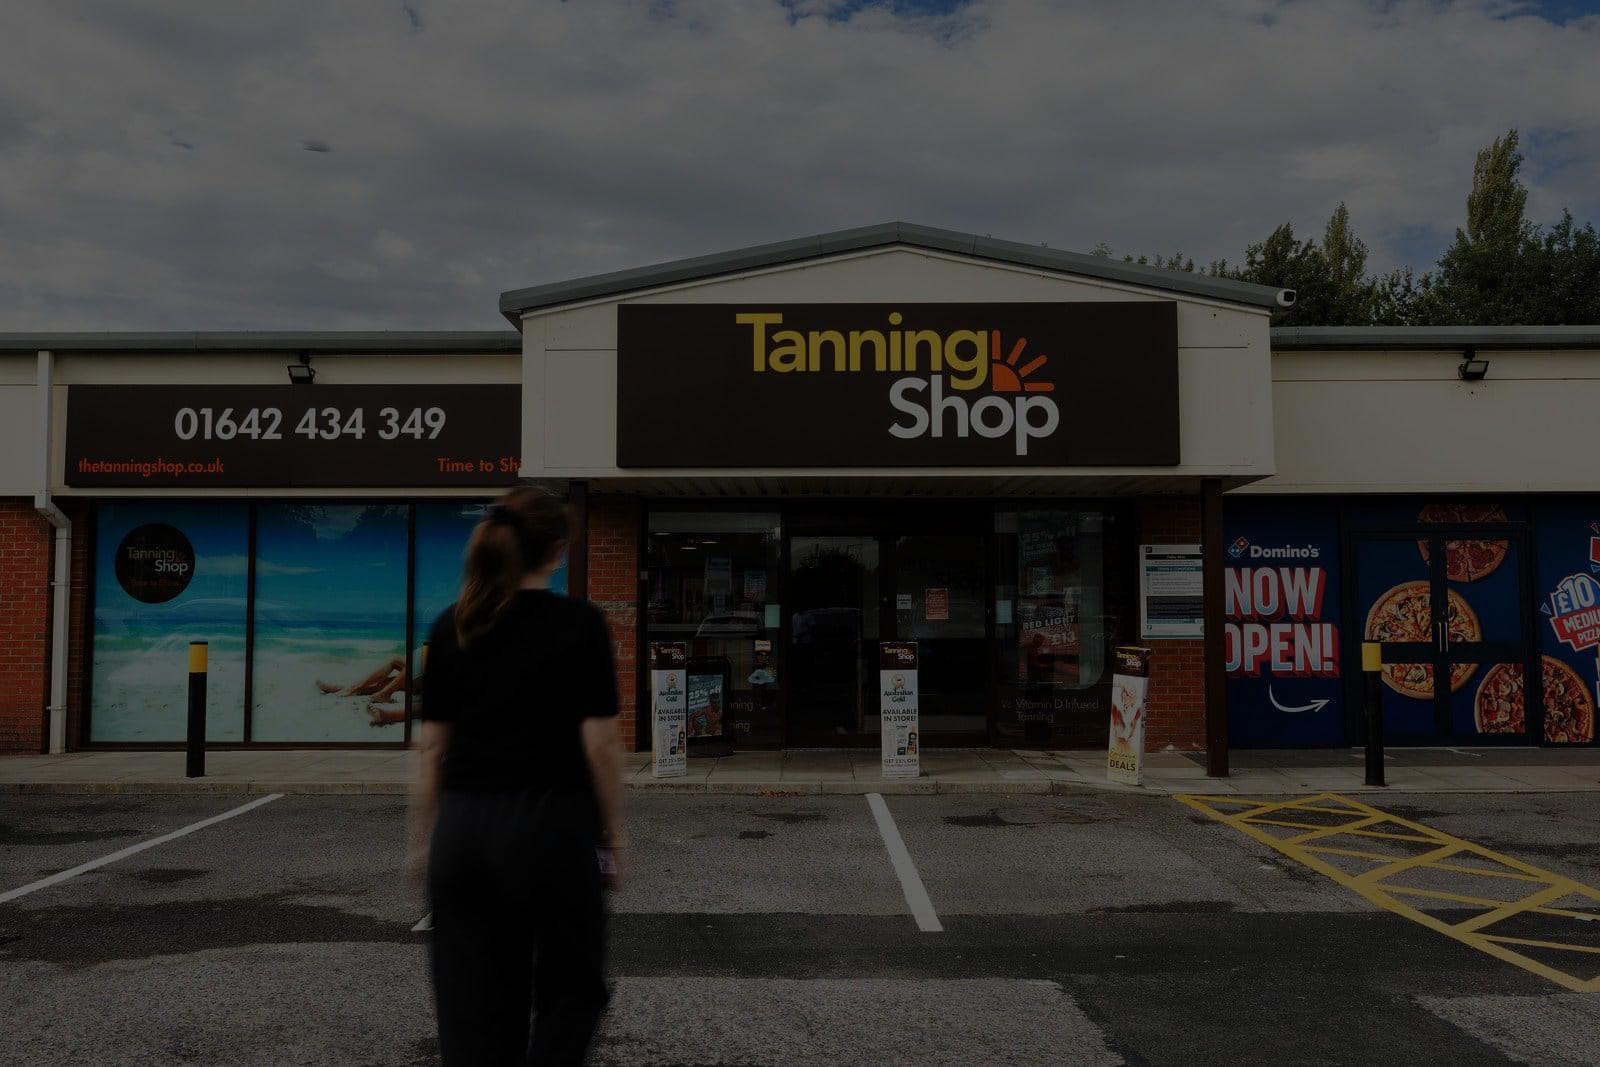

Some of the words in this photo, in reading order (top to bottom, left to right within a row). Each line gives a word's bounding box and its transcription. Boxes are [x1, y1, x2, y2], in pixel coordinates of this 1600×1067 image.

[736, 312, 989, 390] Tanning
[174, 407, 283, 441] 01642
[295, 407, 365, 440] 434
[377, 407, 447, 440] 349
[888, 376, 1060, 456] Shop
[78, 457, 224, 478] thetanningshop.co.uk
[437, 456, 474, 473] Time
[479, 459, 495, 473] to
[499, 456, 519, 473] Sh
[126, 546, 176, 562] Tanning
[1250, 544, 1320, 558] Domino's
[154, 559, 189, 576] Shop
[1224, 566, 1324, 618] NOW
[1558, 575, 1596, 613] £10
[1022, 620, 1042, 631] RED
[1045, 615, 1074, 626] LIGHT
[1563, 609, 1600, 634] MEDIU
[1224, 623, 1336, 674] OPEN!
[897, 653, 915, 662] Shop
[1016, 696, 1053, 709] Vitamin
[658, 714, 667, 722] IN
[1016, 711, 1055, 723] Tanning
[1109, 759, 1136, 771] DEALS
